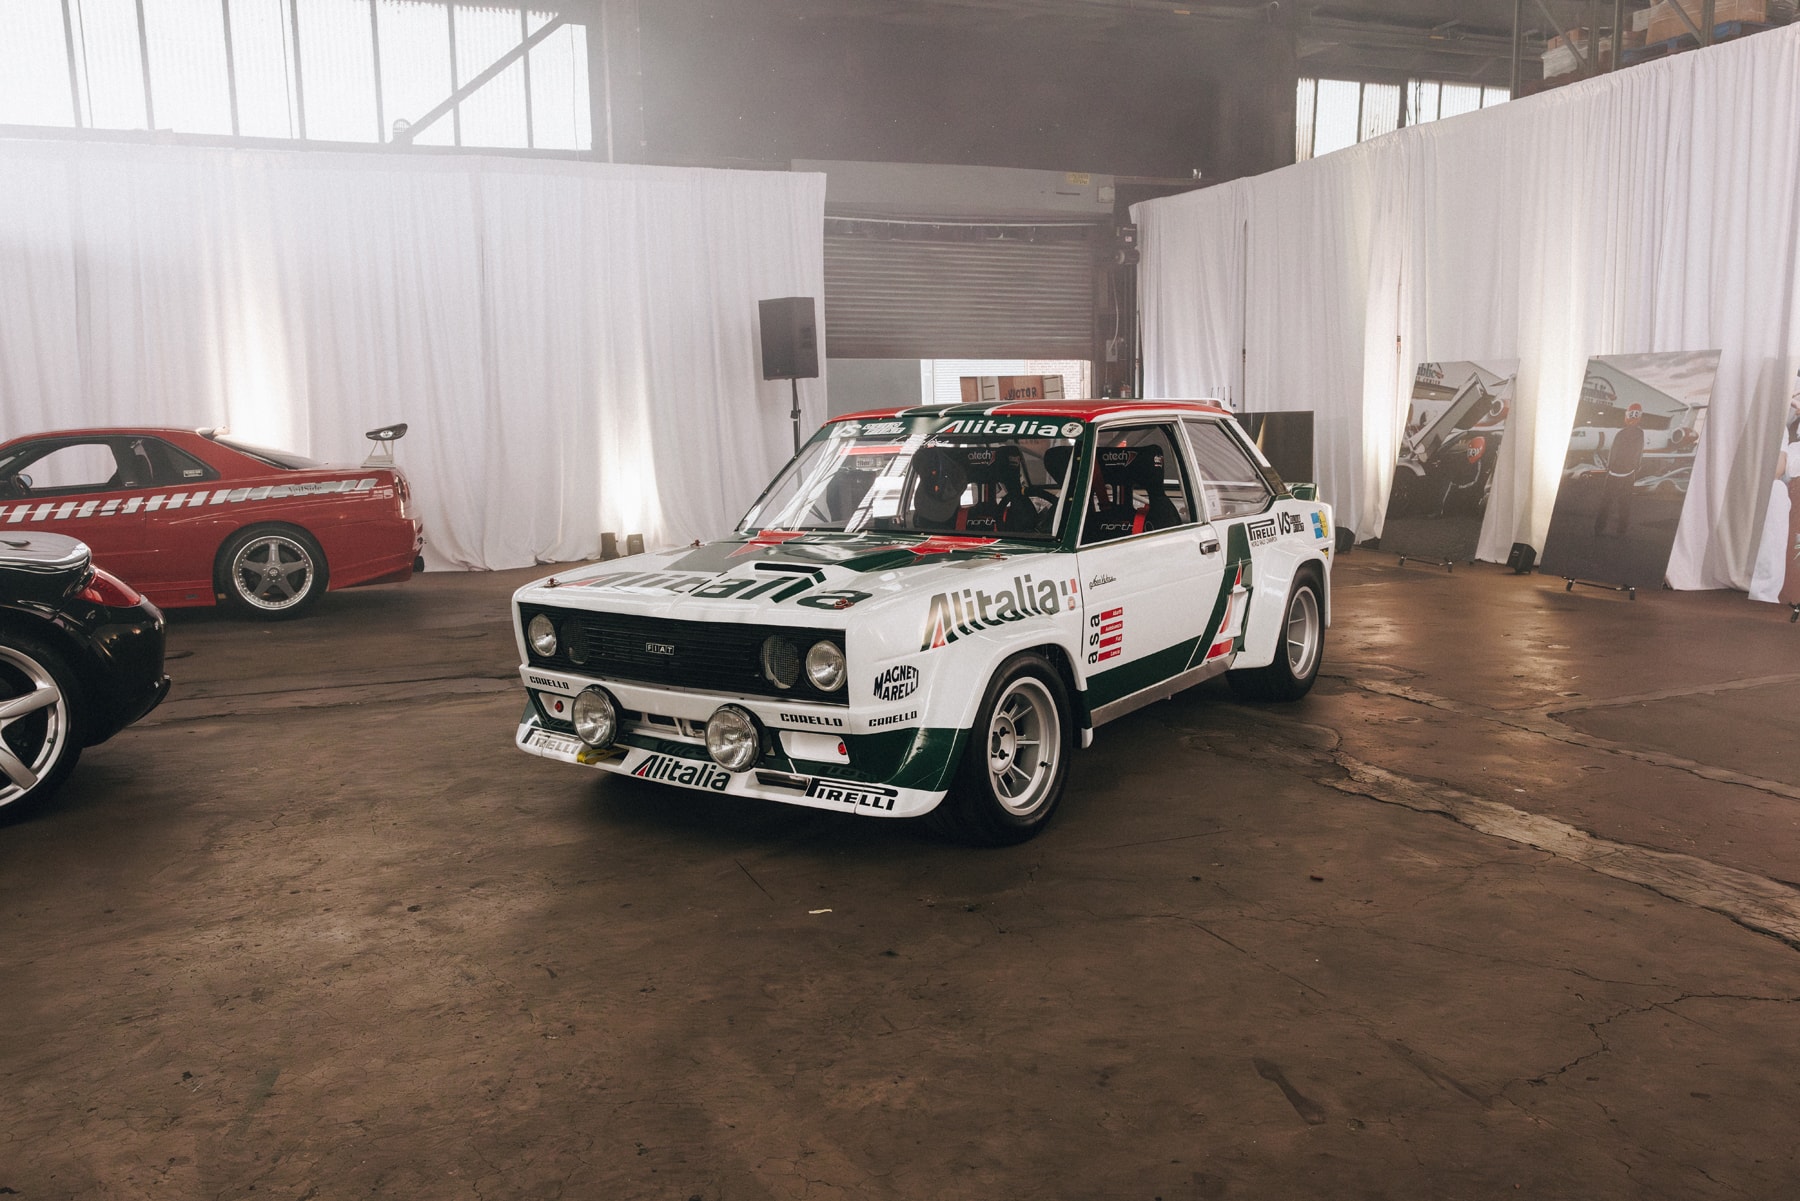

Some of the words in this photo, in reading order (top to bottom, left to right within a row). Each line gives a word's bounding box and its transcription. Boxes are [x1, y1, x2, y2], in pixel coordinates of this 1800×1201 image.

[936, 420, 1059, 437] Alitalia
[1247, 519, 1276, 541] PIRELLI
[1277, 512, 1291, 535] VS
[920, 574, 1060, 652] Alitalia
[645, 642, 674, 655] FIAT
[529, 675, 570, 690] CARELLO
[873, 665, 919, 697] MAGNETI
[780, 713, 843, 727] CARELLO
[868, 710, 918, 727] CARELLO
[522, 728, 582, 755] PIRELLI
[631, 754, 731, 791] Alitalia
[805, 777, 898, 811] PIRELLI
